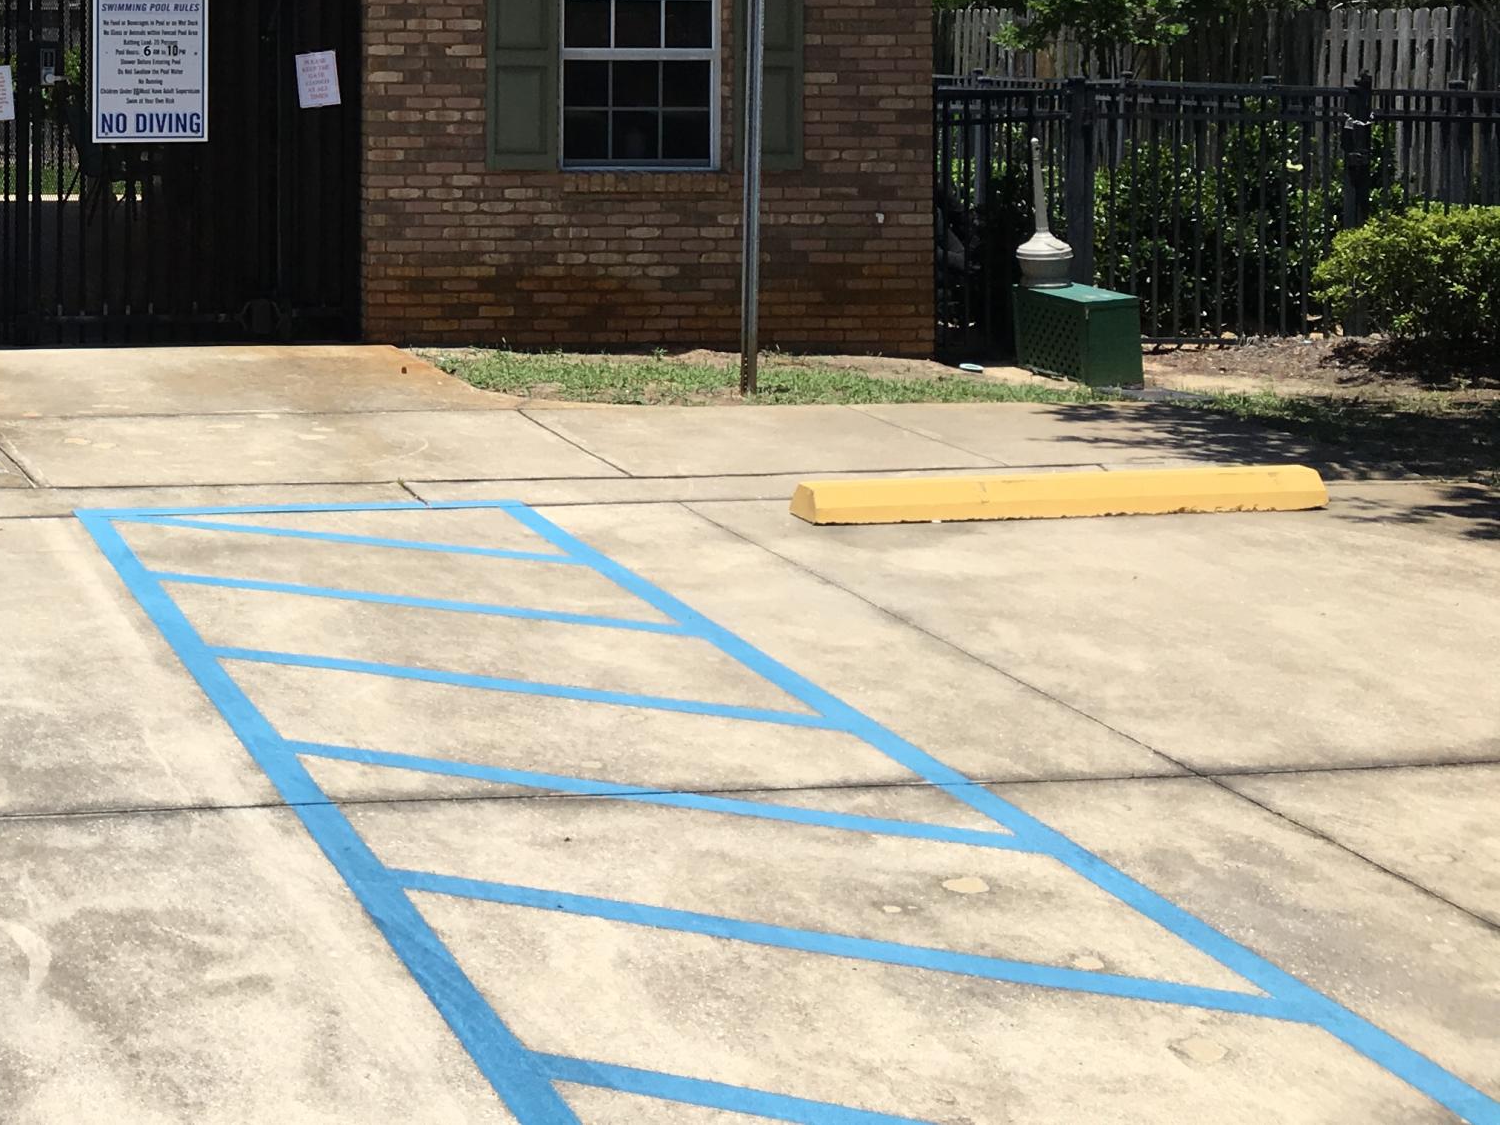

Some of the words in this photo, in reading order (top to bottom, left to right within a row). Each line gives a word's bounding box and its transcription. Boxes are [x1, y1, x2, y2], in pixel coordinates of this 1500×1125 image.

[101, 3, 147, 12] SWIMMING
[150, 4, 170, 12] POOL
[173, 4, 200, 12] RULES
[143, 46, 151, 56] 6
[168, 45, 179, 56] 10
[101, 113, 127, 133] NO
[136, 113, 201, 134] DIVING
